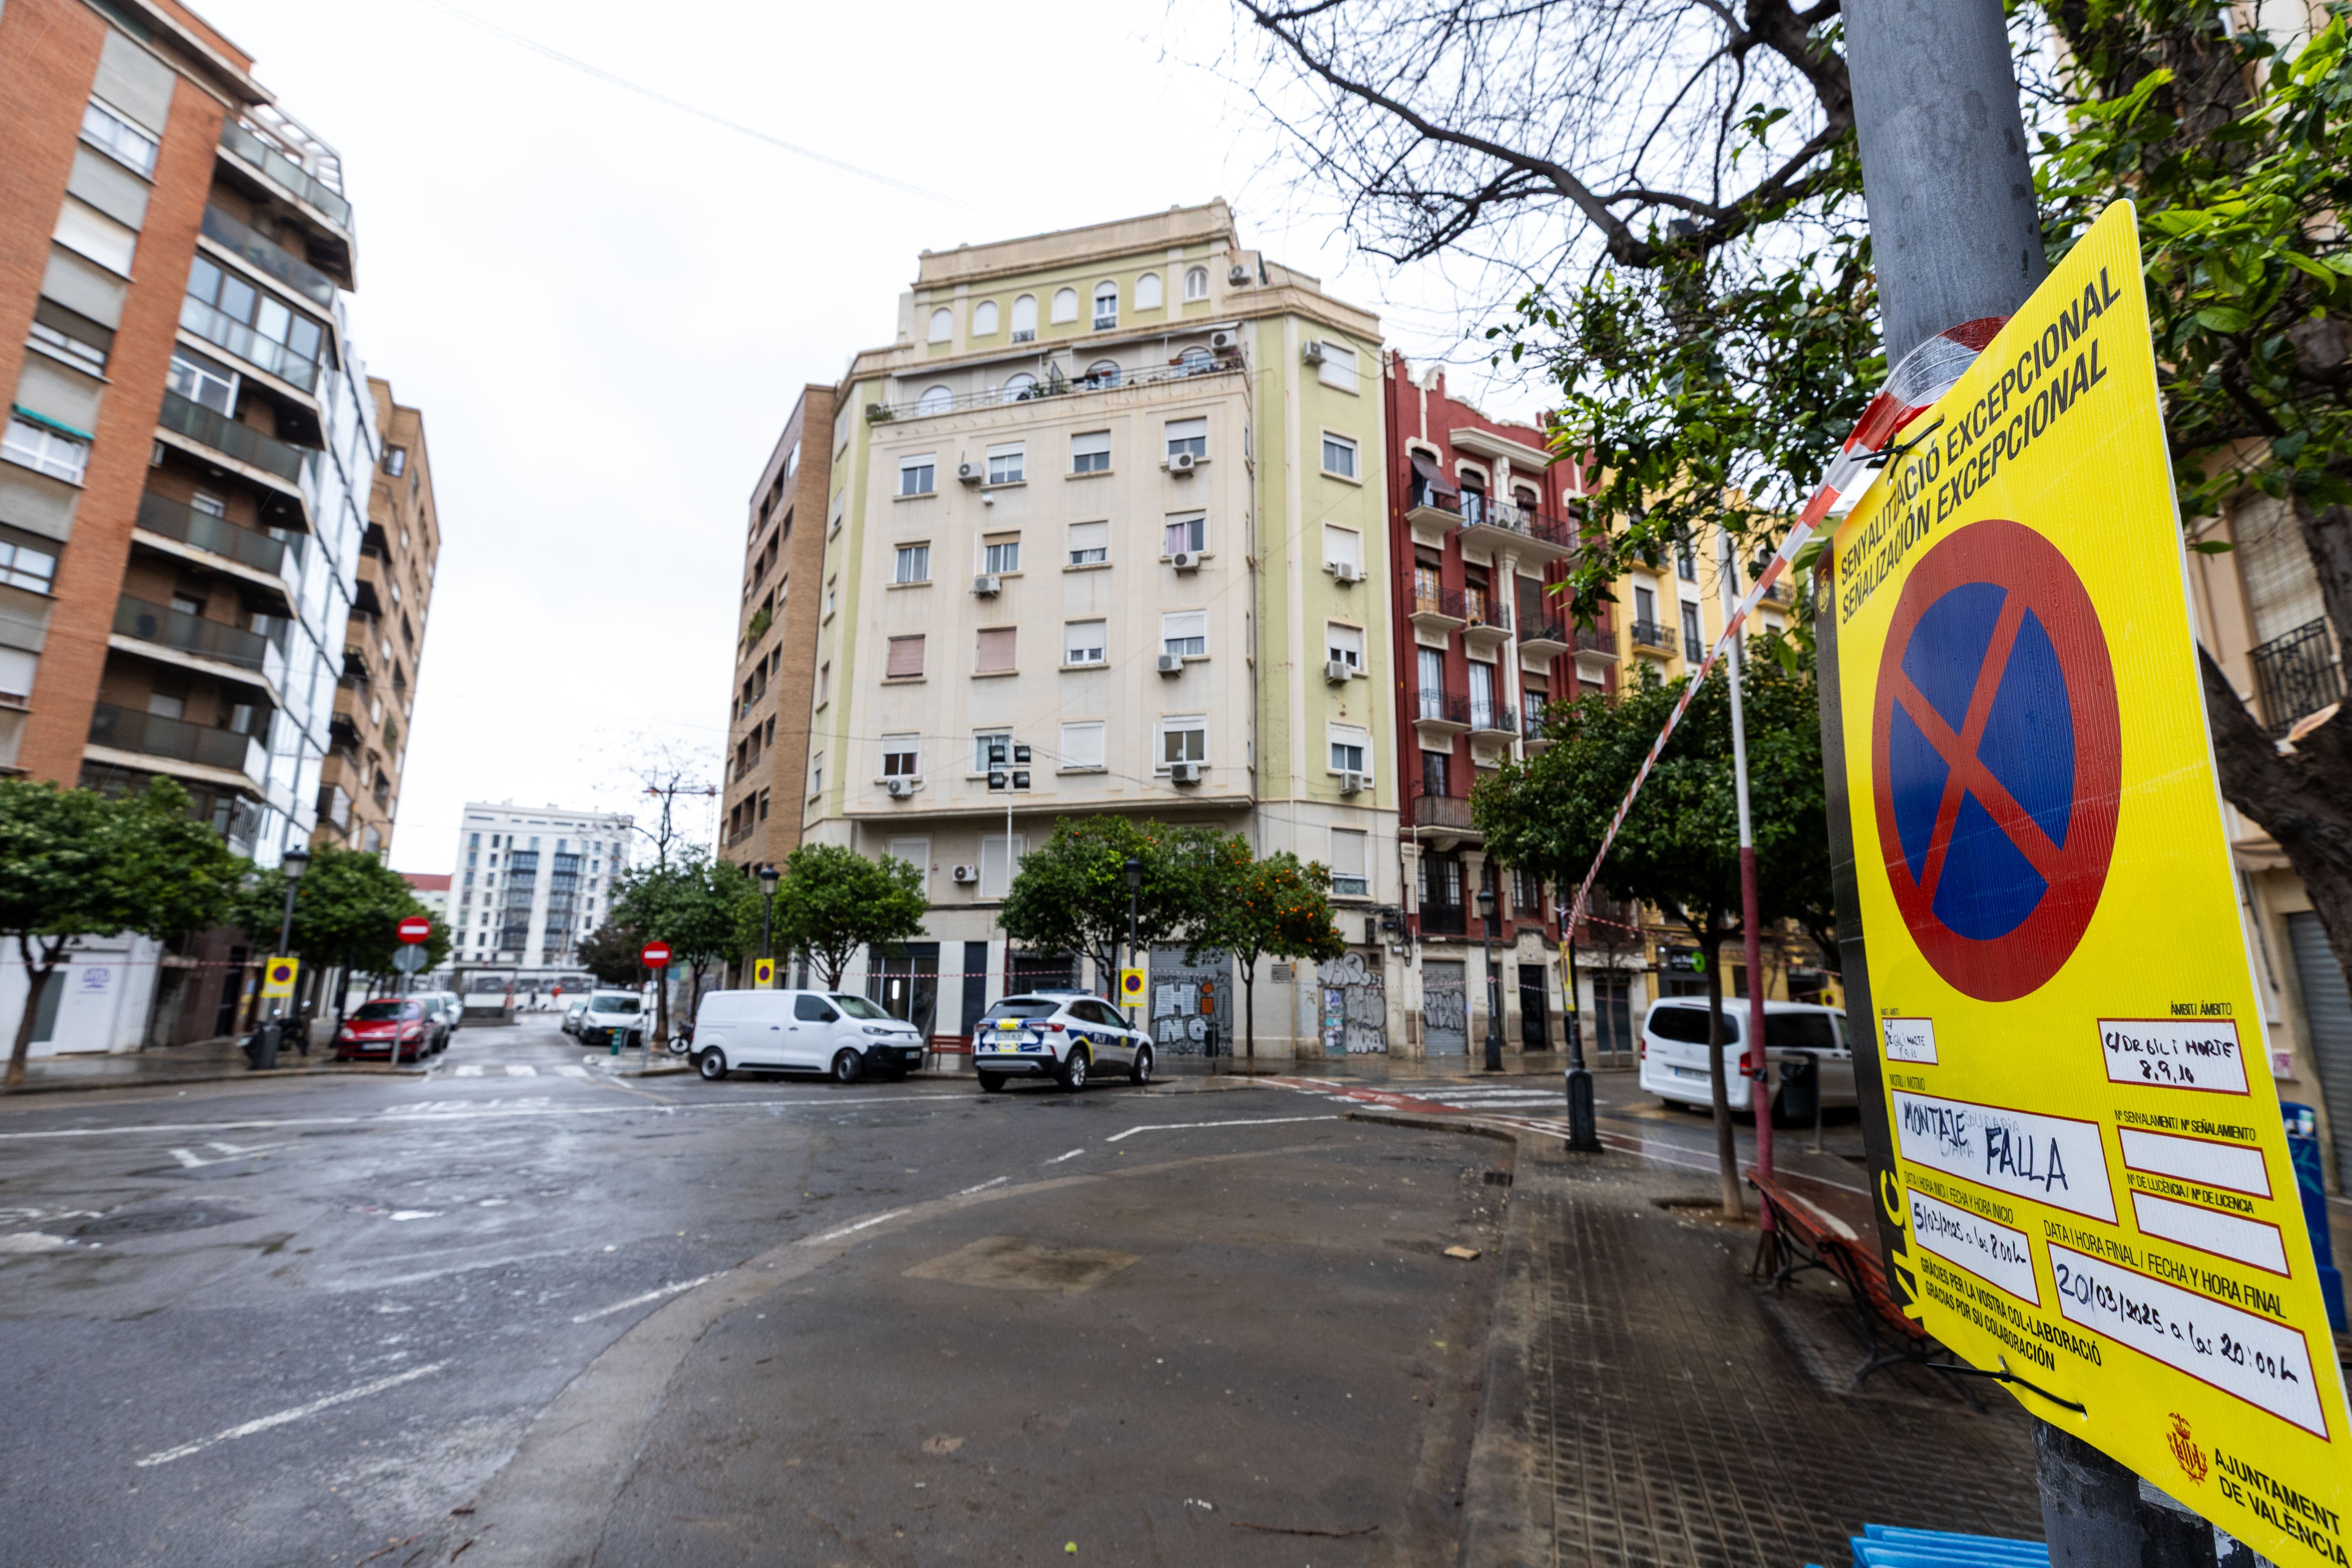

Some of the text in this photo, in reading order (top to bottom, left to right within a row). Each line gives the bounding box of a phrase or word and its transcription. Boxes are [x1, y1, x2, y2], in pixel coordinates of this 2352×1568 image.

[1842, 265, 2120, 586] SENYALITZACIÓ EXCEPCIONAL
[1843, 338, 2107, 625] SEÑALIZACIÓN EXCEPCIONAL
[2200, 1000, 2232, 1015] ÁMBITO
[2122, 1035, 2143, 1052] DR
[1907, 1076, 1925, 1091] MOTIVO
[1903, 1099, 1968, 1147] MONTAJE
[2191, 1119, 2256, 1141] SEÑALAMIENTO
[1985, 1126, 2068, 1192] FALLA
[1904, 1171, 1916, 1186] DATA
[1919, 1176, 1934, 1194] HORA
[1950, 1188, 1968, 1205] FECHA
[1967, 1191, 1973, 1206] Y
[1974, 1196, 1992, 1216] HORA
[1992, 1203, 2013, 1224] INICIO
[1914, 1202, 1964, 1241] 5/03/2025
[1967, 1232, 1973, 1244] a
[2136, 1175, 2147, 1188] DE
[2203, 1190, 2215, 1205] DE
[2215, 1193, 2254, 1214] LICENCIA
[1920, 1256, 1949, 1286] GRÀCIES
[1949, 1272, 1965, 1295] PER
[1965, 1280, 1976, 1301] LA
[1976, 1286, 2007, 1320] VOSTRA
[2043, 1219, 2069, 1244] DATA
[2076, 1229, 2104, 1257] HORA
[2106, 1240, 2139, 1268] FINAL
[2148, 1252, 2188, 1285] FECHA
[2189, 1265, 2199, 1288] Y
[2201, 1269, 2241, 1303] HORA
[2243, 1284, 2287, 1319] FINAL
[1926, 1280, 2055, 1371] GRACIAS POR SU COLABORACIÓN
[2056, 1263, 2164, 1334] 20/03/2025
[2170, 1322, 2185, 1341] a
[2215, 1447, 2340, 1536] AJUNTAMENT
[2218, 1474, 2351, 1568] DE VALÈNCIA
